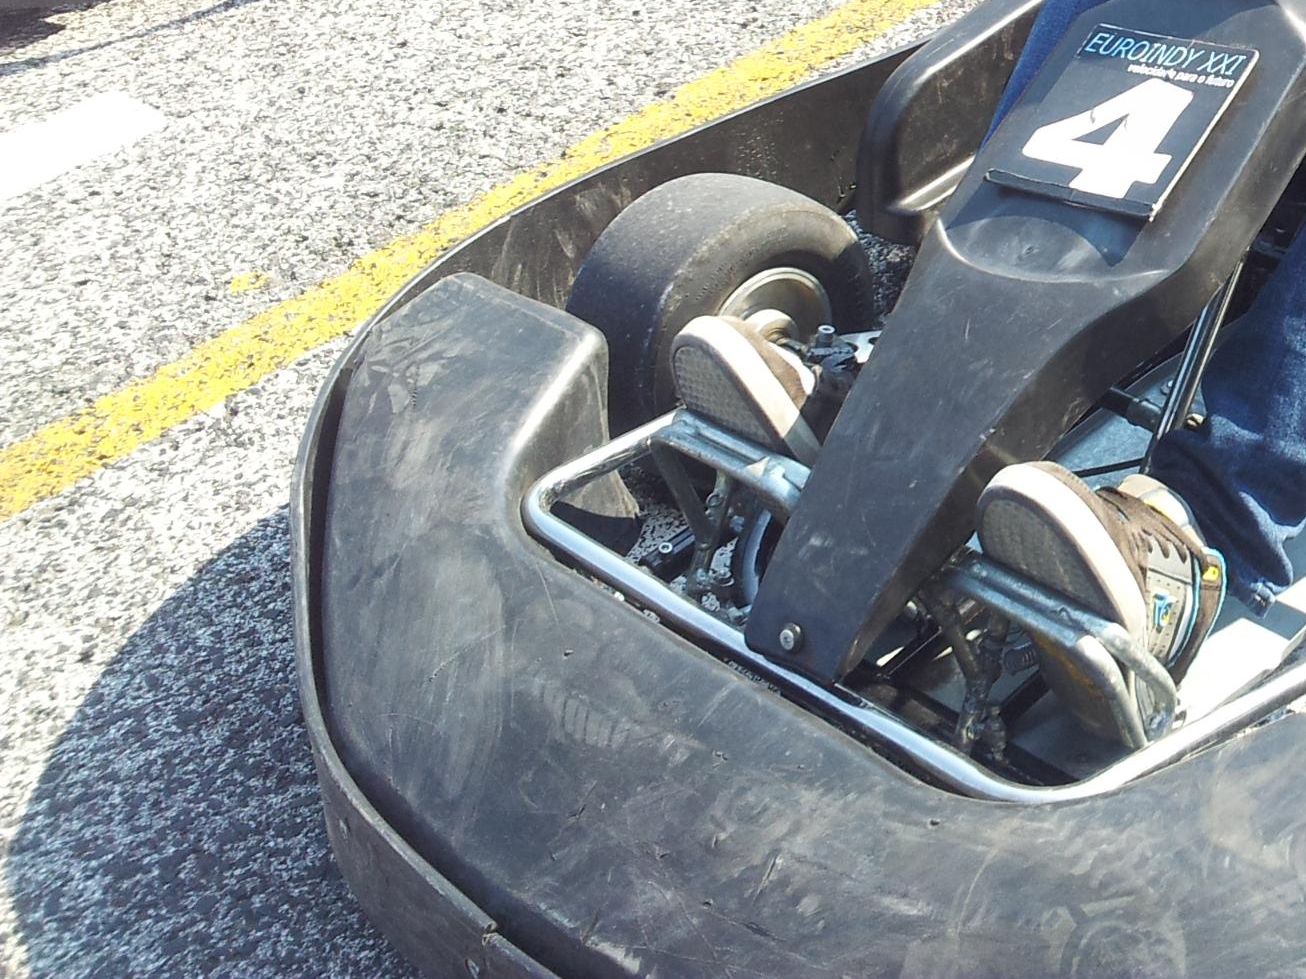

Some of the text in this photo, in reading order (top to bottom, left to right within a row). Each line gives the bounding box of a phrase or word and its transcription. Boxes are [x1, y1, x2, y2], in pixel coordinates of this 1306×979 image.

[1085, 32, 1247, 76] EUROINDY XXI
[1022, 77, 1195, 199] 4
